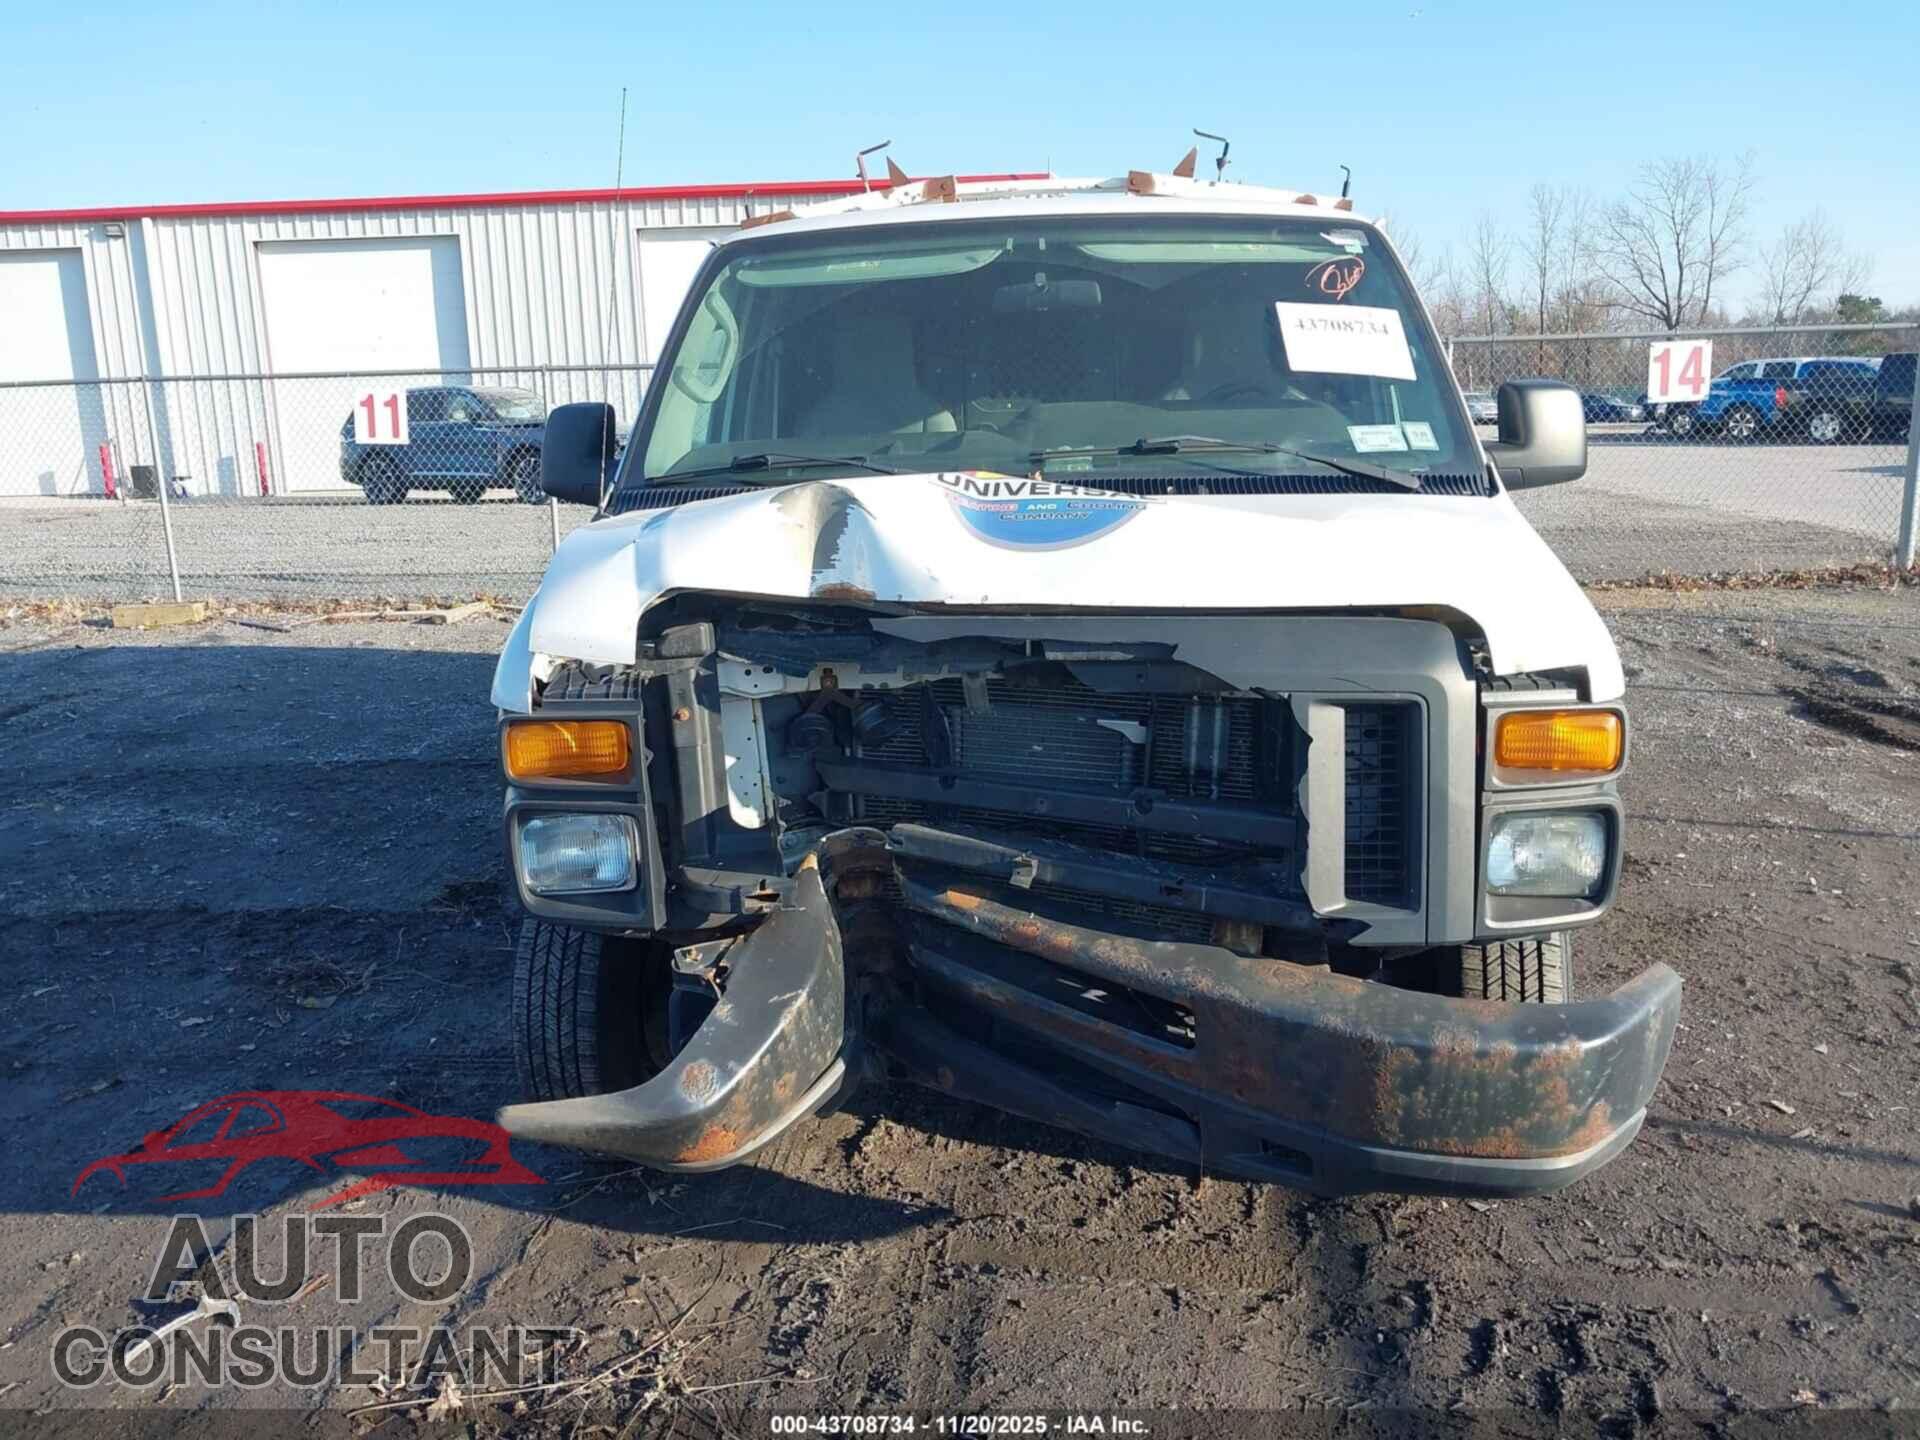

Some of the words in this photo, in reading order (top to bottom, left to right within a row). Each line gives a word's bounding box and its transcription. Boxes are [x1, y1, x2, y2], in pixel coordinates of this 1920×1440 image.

[1295, 318, 1389, 336] 43708734
[1653, 346, 1705, 396] 14
[359, 393, 400, 438] 11
[1026, 503, 1057, 511] AND
